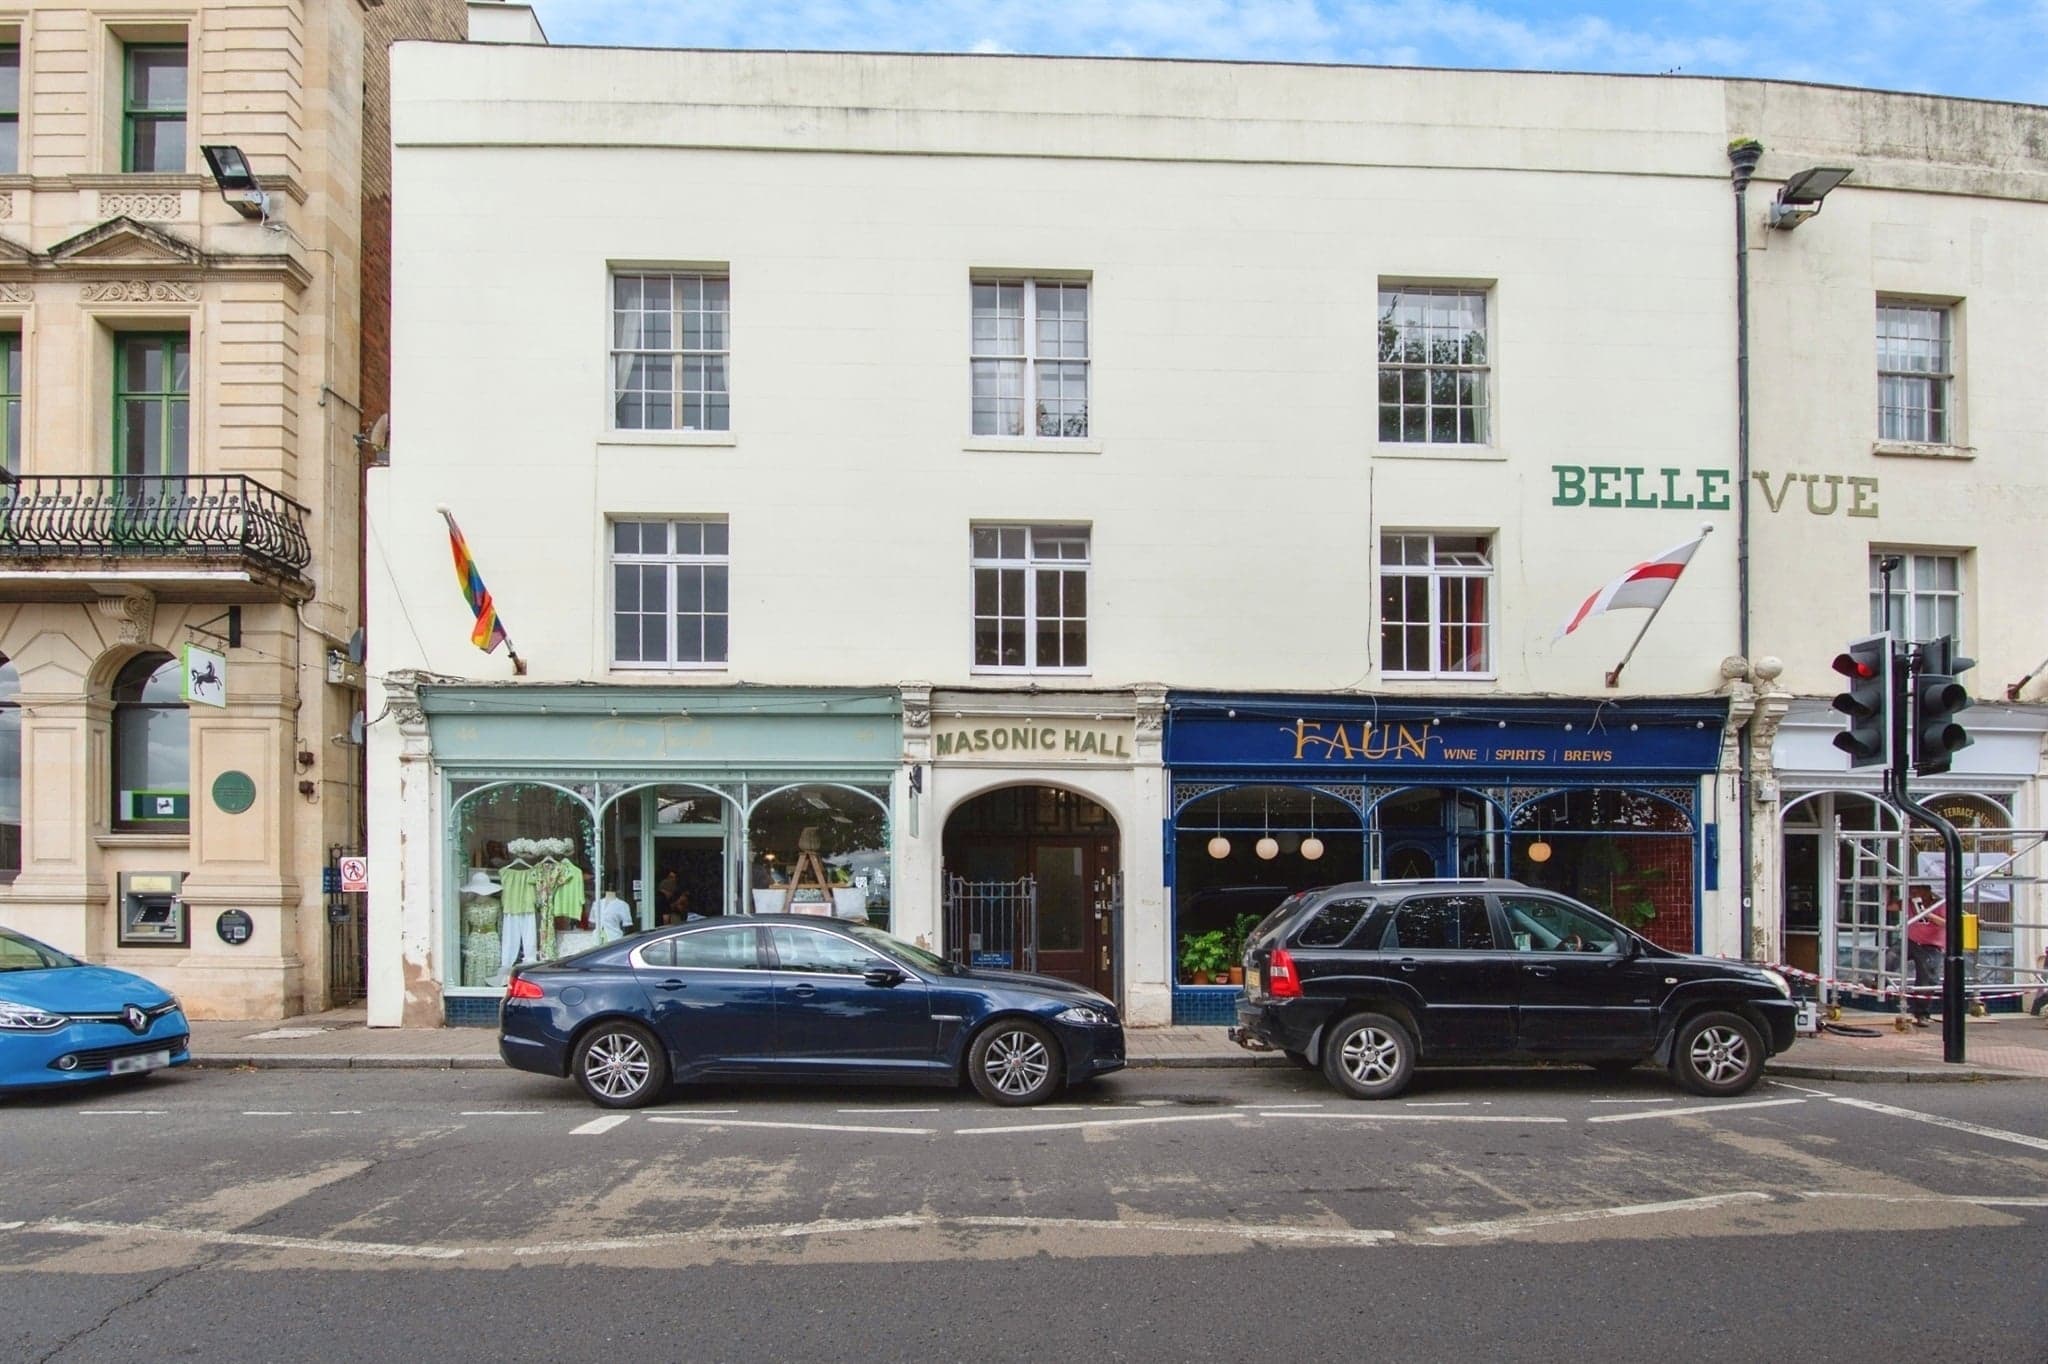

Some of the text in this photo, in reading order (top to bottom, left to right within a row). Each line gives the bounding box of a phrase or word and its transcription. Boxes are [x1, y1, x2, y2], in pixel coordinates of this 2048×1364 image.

[1551, 465, 1879, 518] BELLE VUE
[936, 727, 1131, 758] MASONIC HALL
[1280, 721, 1443, 760] FAUN
[1443, 748, 1613, 762] WINE SPIRITS BREWS
[1943, 806, 1974, 818] TERRACE
